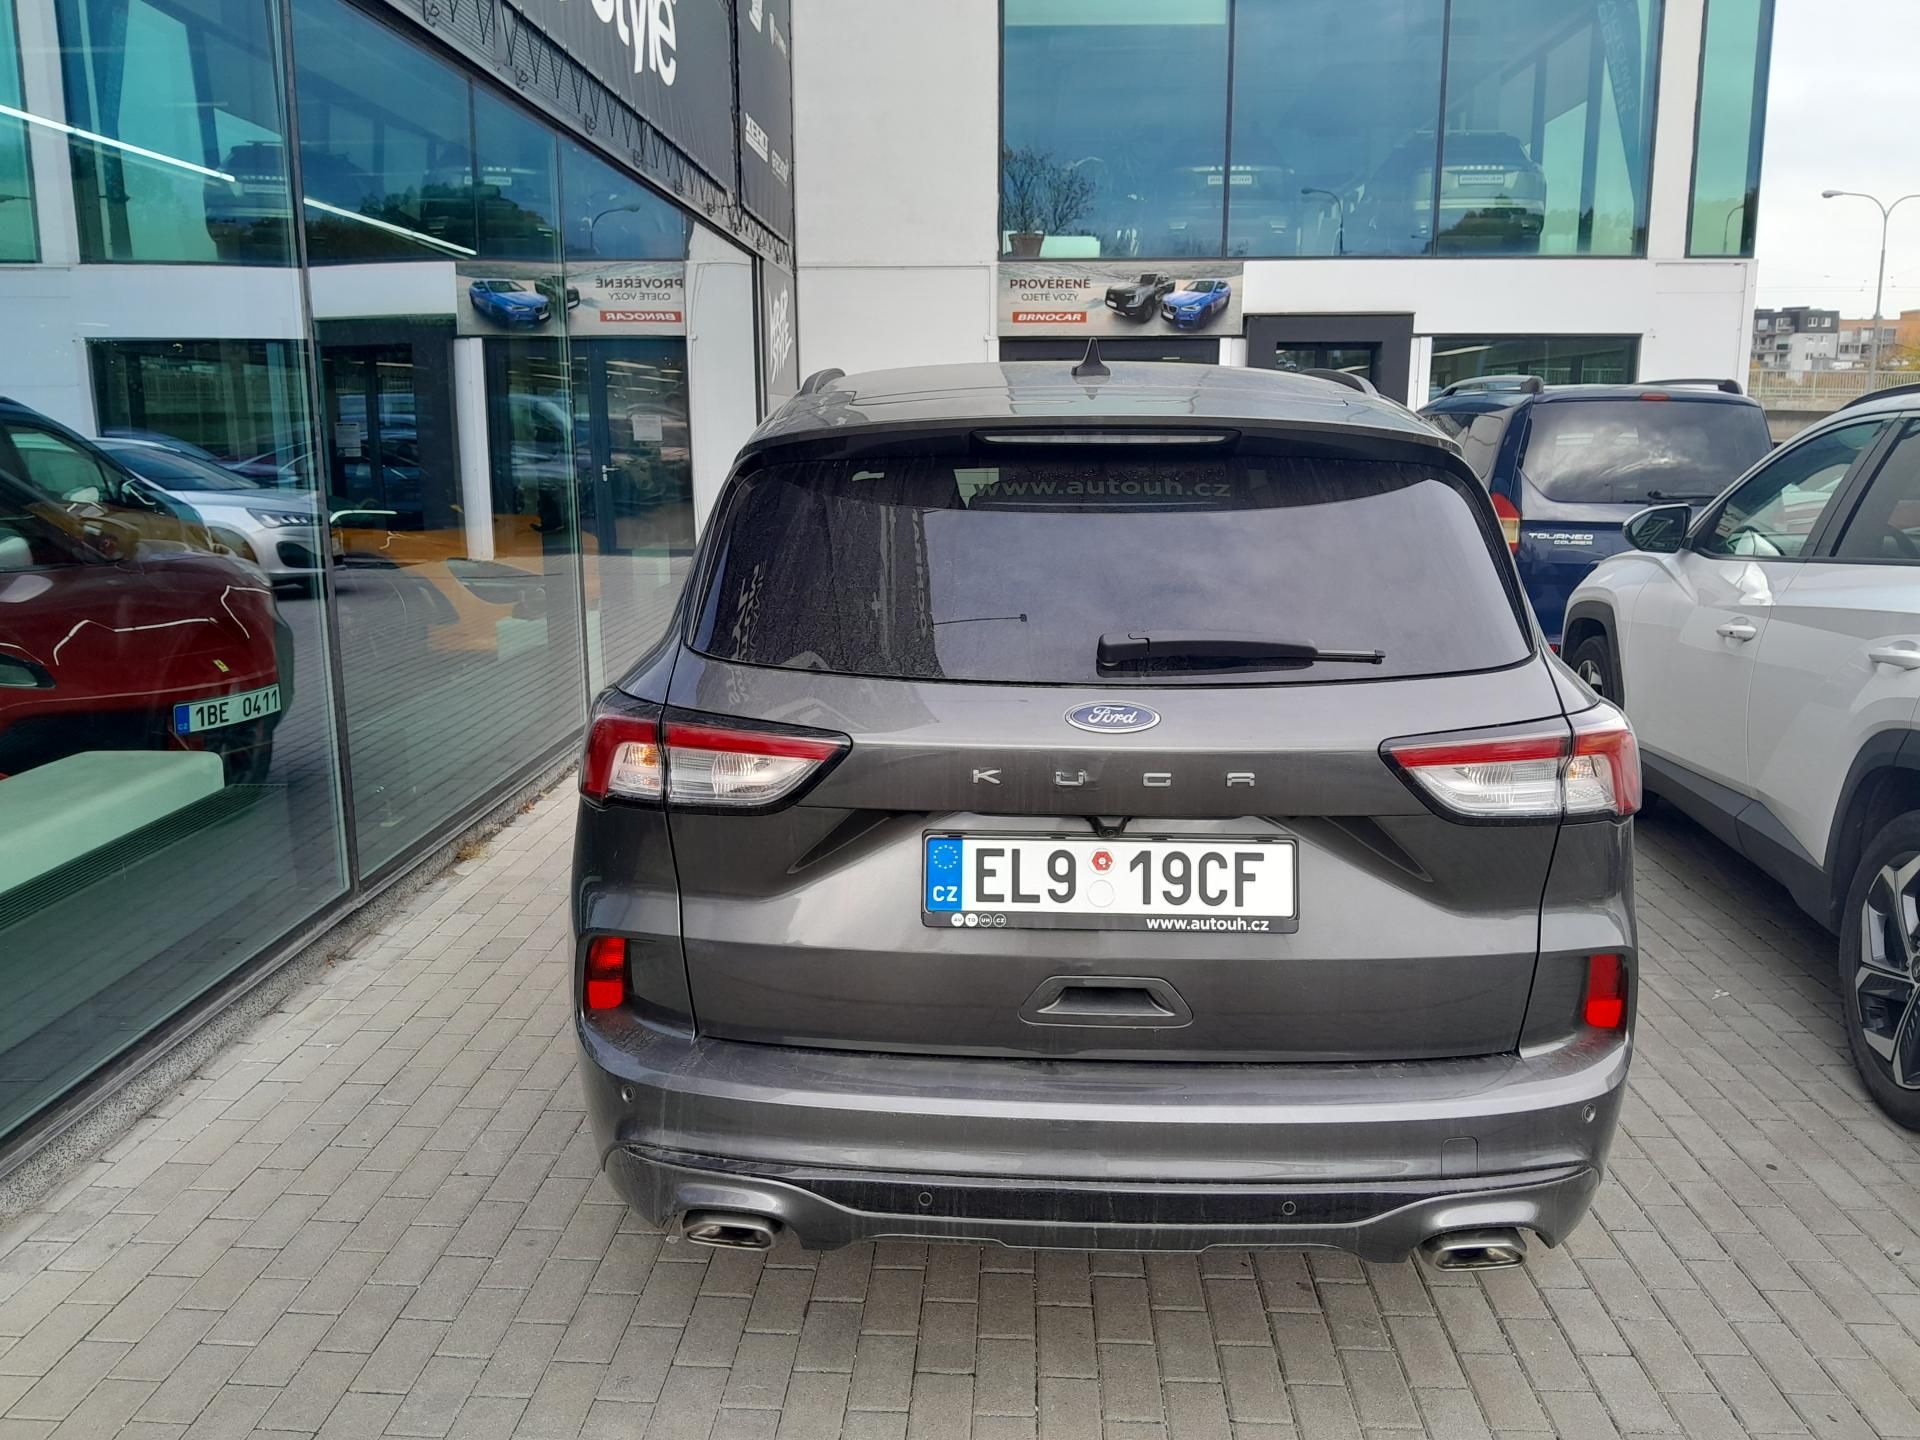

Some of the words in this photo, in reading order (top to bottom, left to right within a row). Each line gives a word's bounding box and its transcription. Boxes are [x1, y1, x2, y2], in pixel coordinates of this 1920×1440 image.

[591, 0, 677, 87] yle
[1009, 276, 1091, 289] PROVĚŘENÉ
[1021, 292, 1050, 301] OJETÉ
[1052, 293, 1079, 301] VOZY
[1017, 313, 1082, 321] BRNOCAR
[974, 478, 1231, 497] www.autouh.cz
[196, 702, 229, 727] 1BE
[243, 689, 277, 717] 0411
[1087, 706, 1138, 724] Ford
[975, 848, 1077, 904] EL9
[1129, 850, 1265, 908] 19CF
[932, 885, 958, 902] CZ
[1146, 917, 1270, 931] www.autouh.cz
